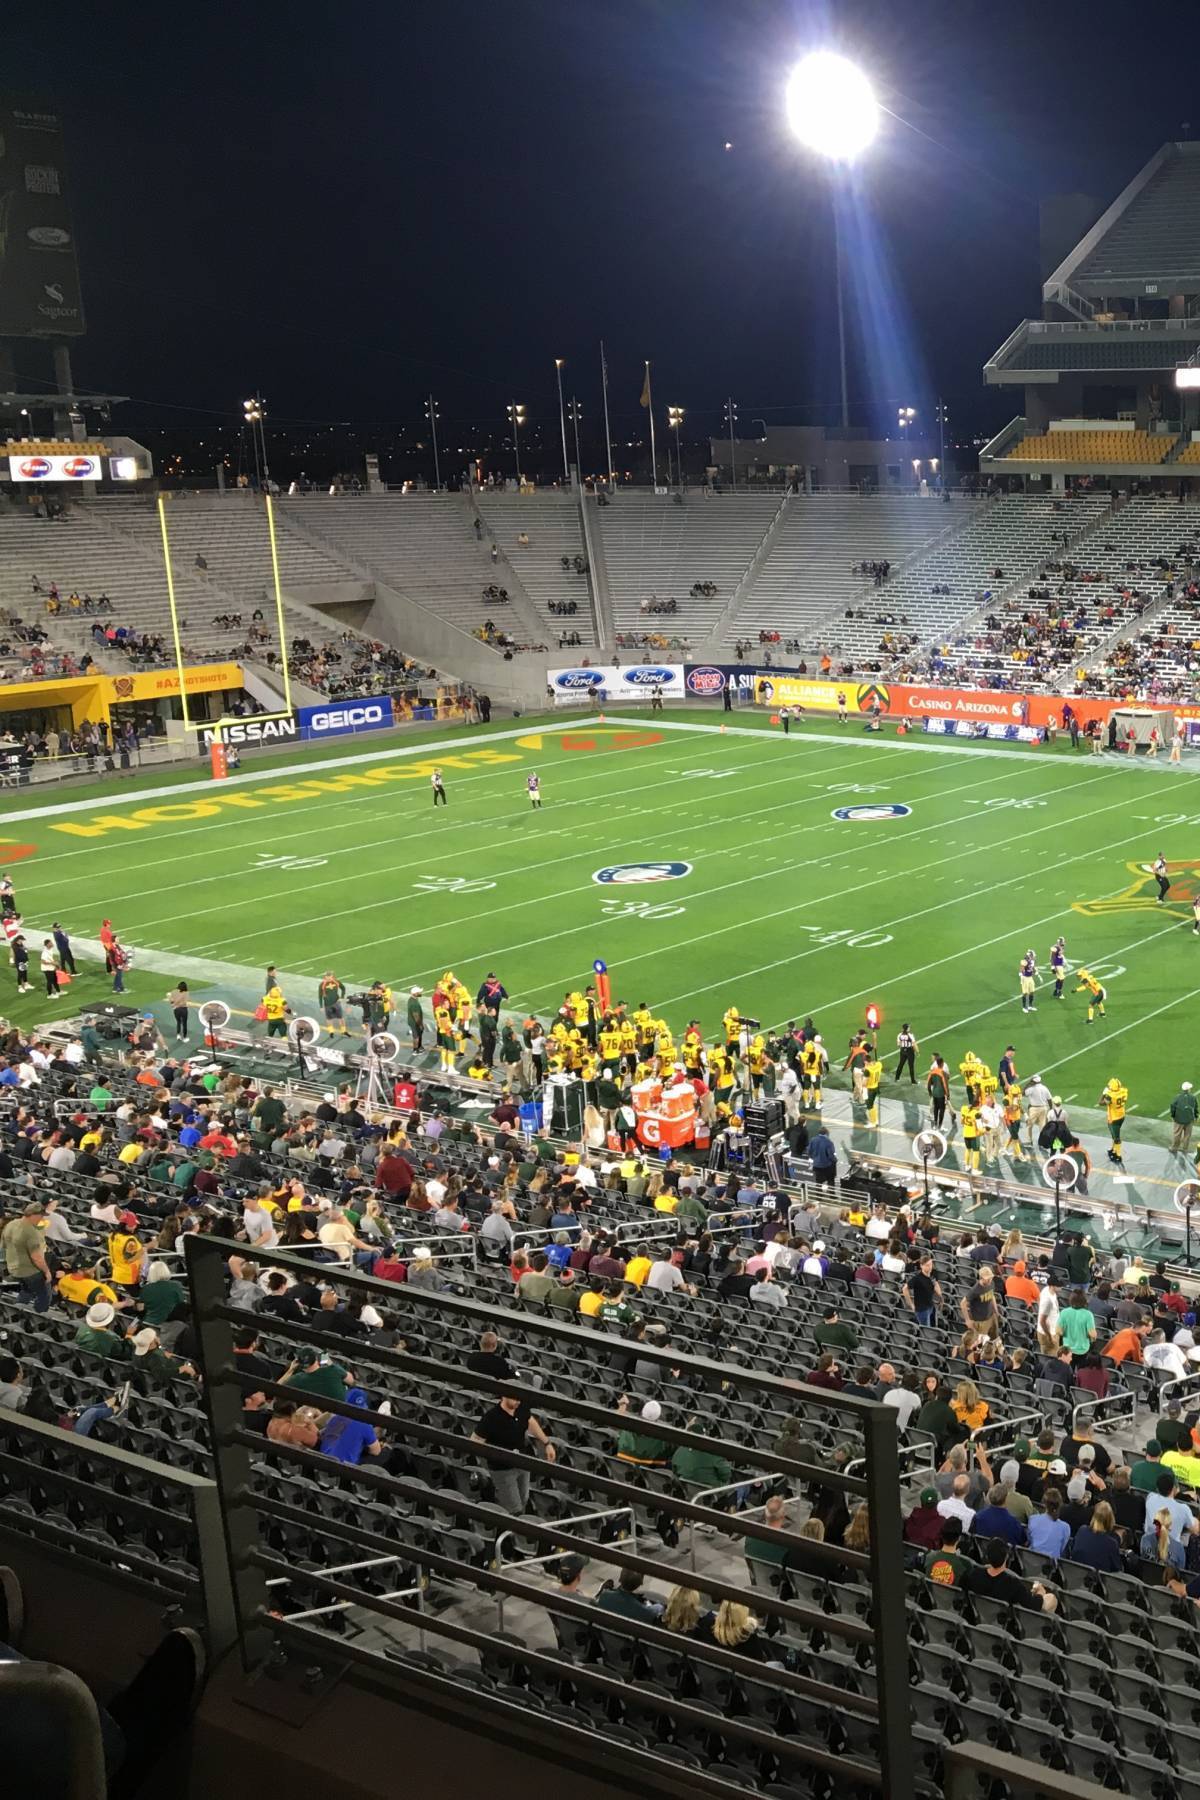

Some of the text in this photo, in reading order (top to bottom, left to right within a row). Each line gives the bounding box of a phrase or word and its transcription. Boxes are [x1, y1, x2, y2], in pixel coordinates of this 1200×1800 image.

[565, 673, 594, 687] Ford
[633, 670, 665, 682] Ford
[779, 684, 836, 697] ALLIANCE
[908, 695, 1008, 715] CASINO ARIZONA
[311, 705, 382, 731] GEICO
[204, 718, 296, 746] NISSAN
[48, 750, 525, 837] HOTSHOTS
[248, 855, 328, 870] 10
[412, 877, 497, 893] 20
[601, 901, 686, 919] 30
[808, 930, 894, 947] 40
[605, 1039, 618, 1050] 76
[642, 1120, 661, 1143] G
